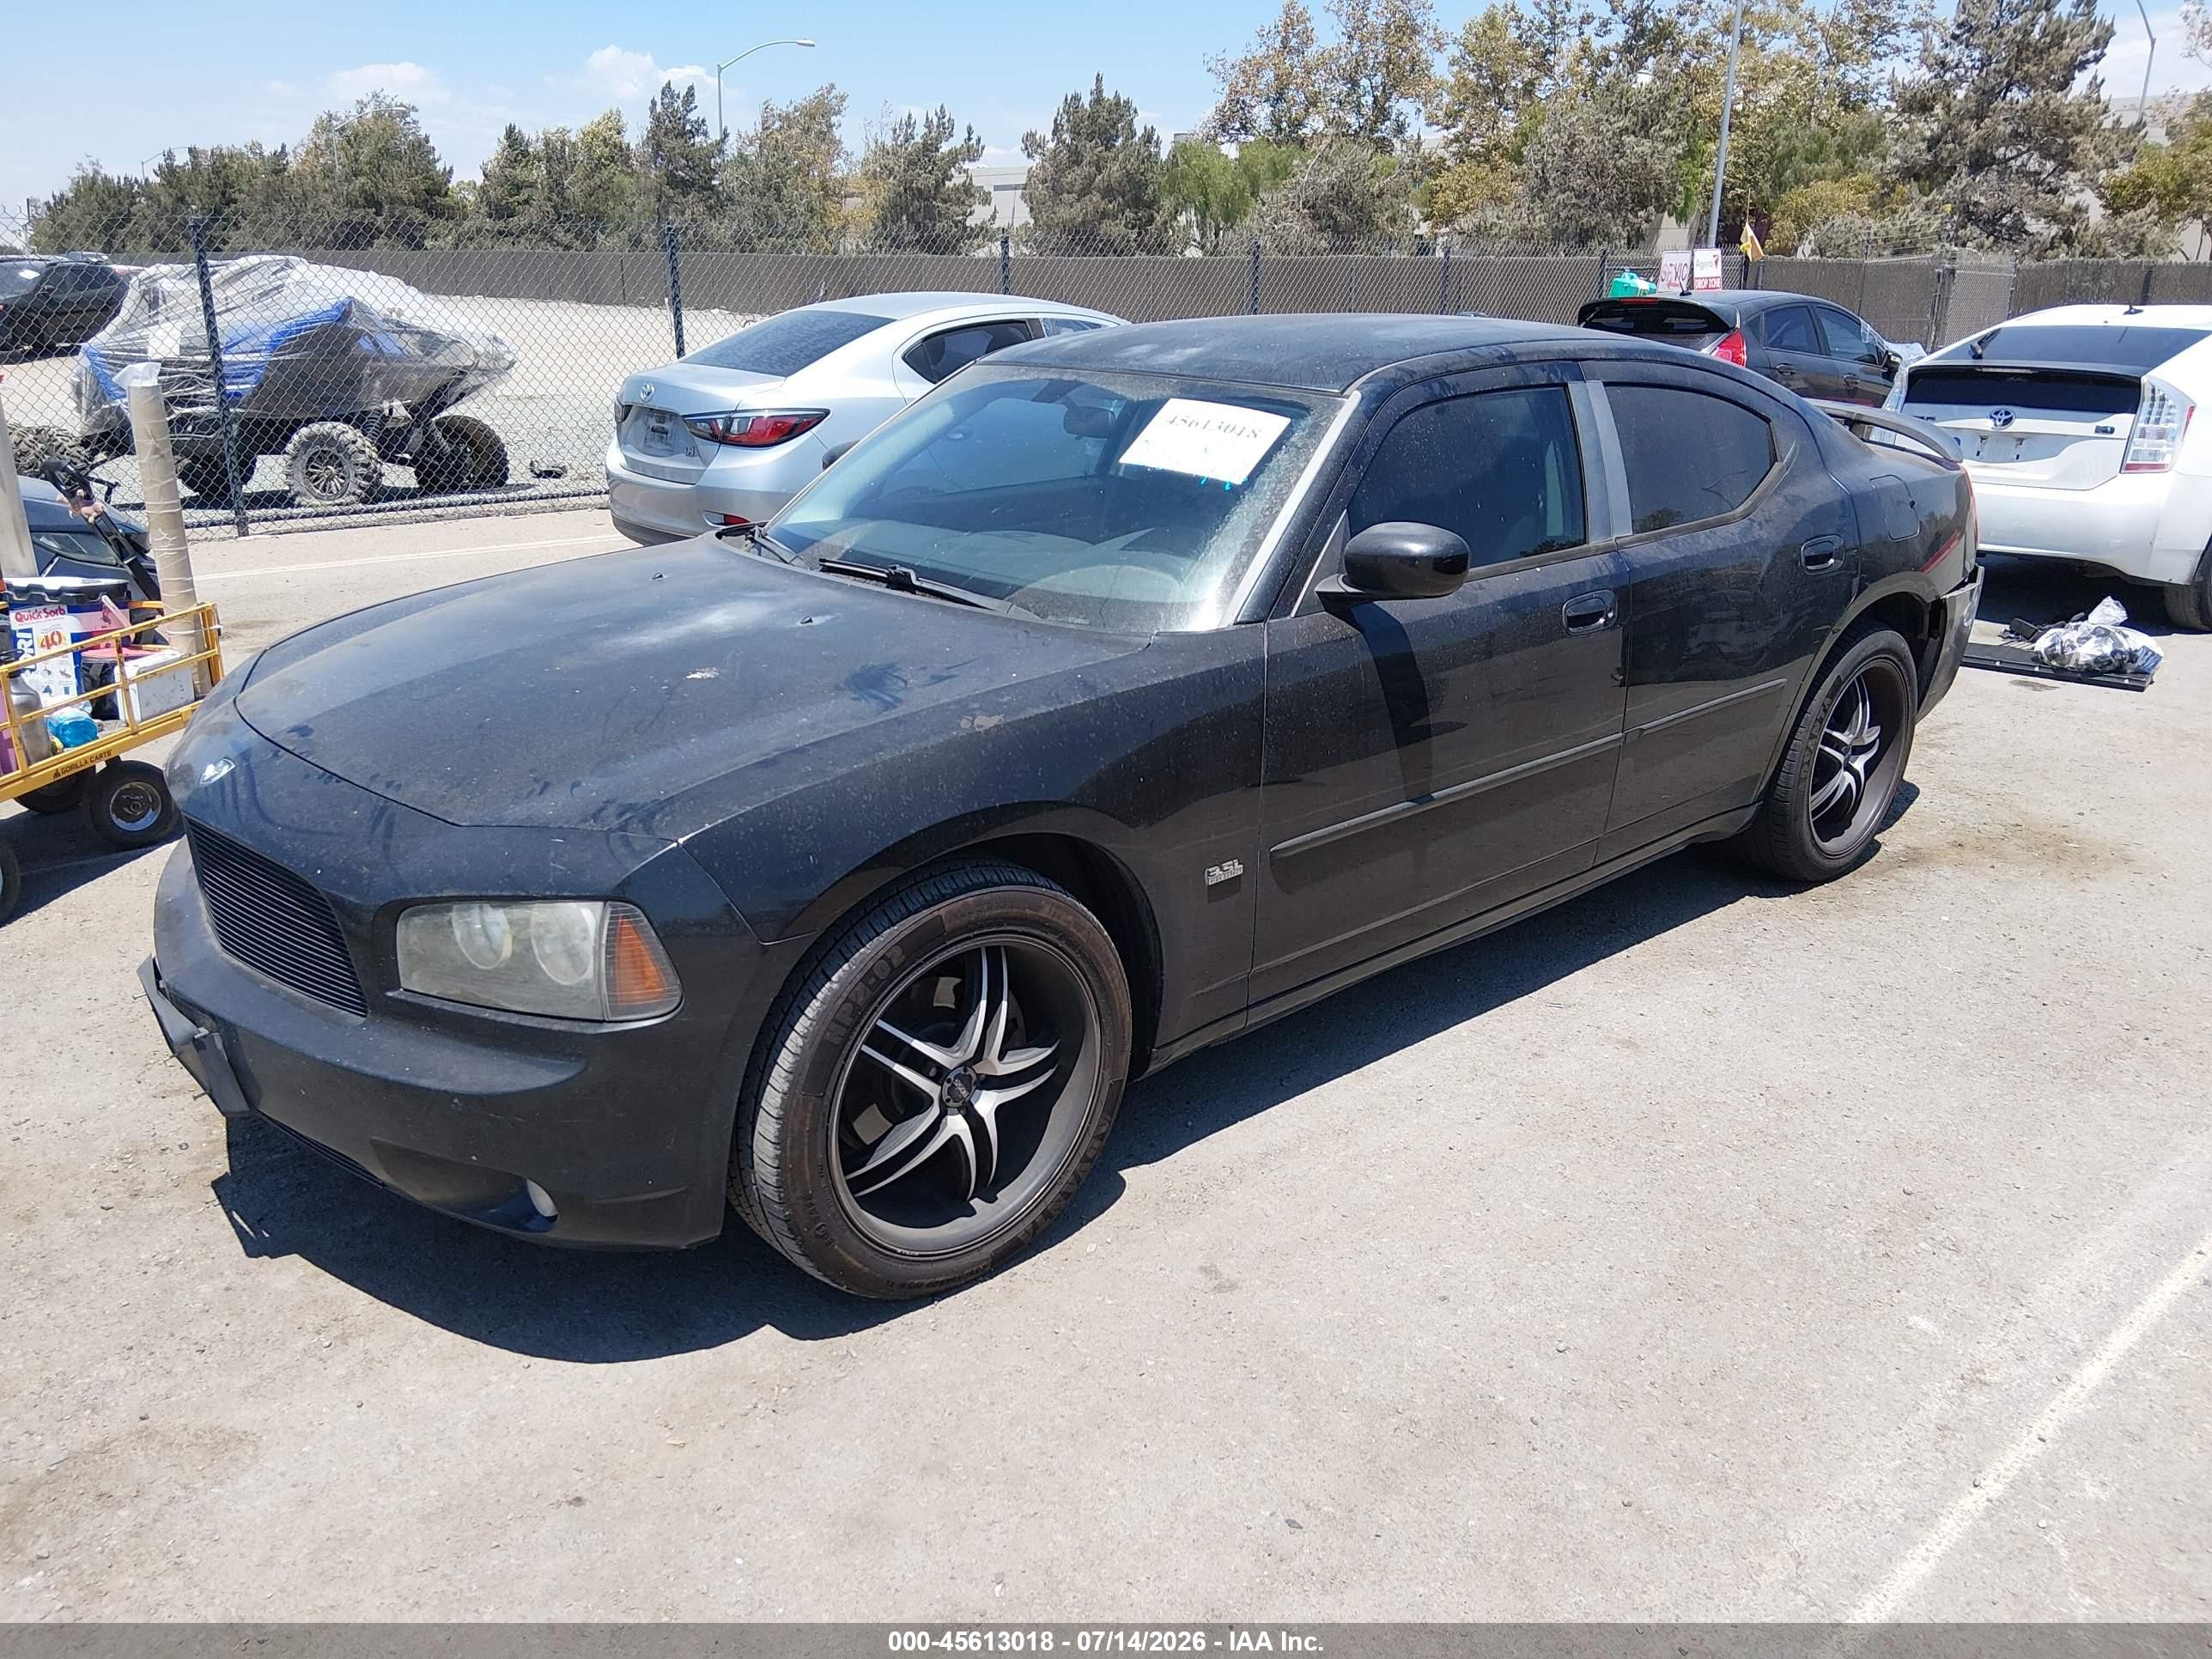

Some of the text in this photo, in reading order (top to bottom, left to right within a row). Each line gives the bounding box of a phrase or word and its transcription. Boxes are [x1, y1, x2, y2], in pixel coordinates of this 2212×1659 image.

[1695, 277, 1721, 289] DROP ZONE
[43, 605, 66, 618] Sorb
[40, 630, 63, 650] 40
[61, 750, 112, 775] GORILLA CARTS
